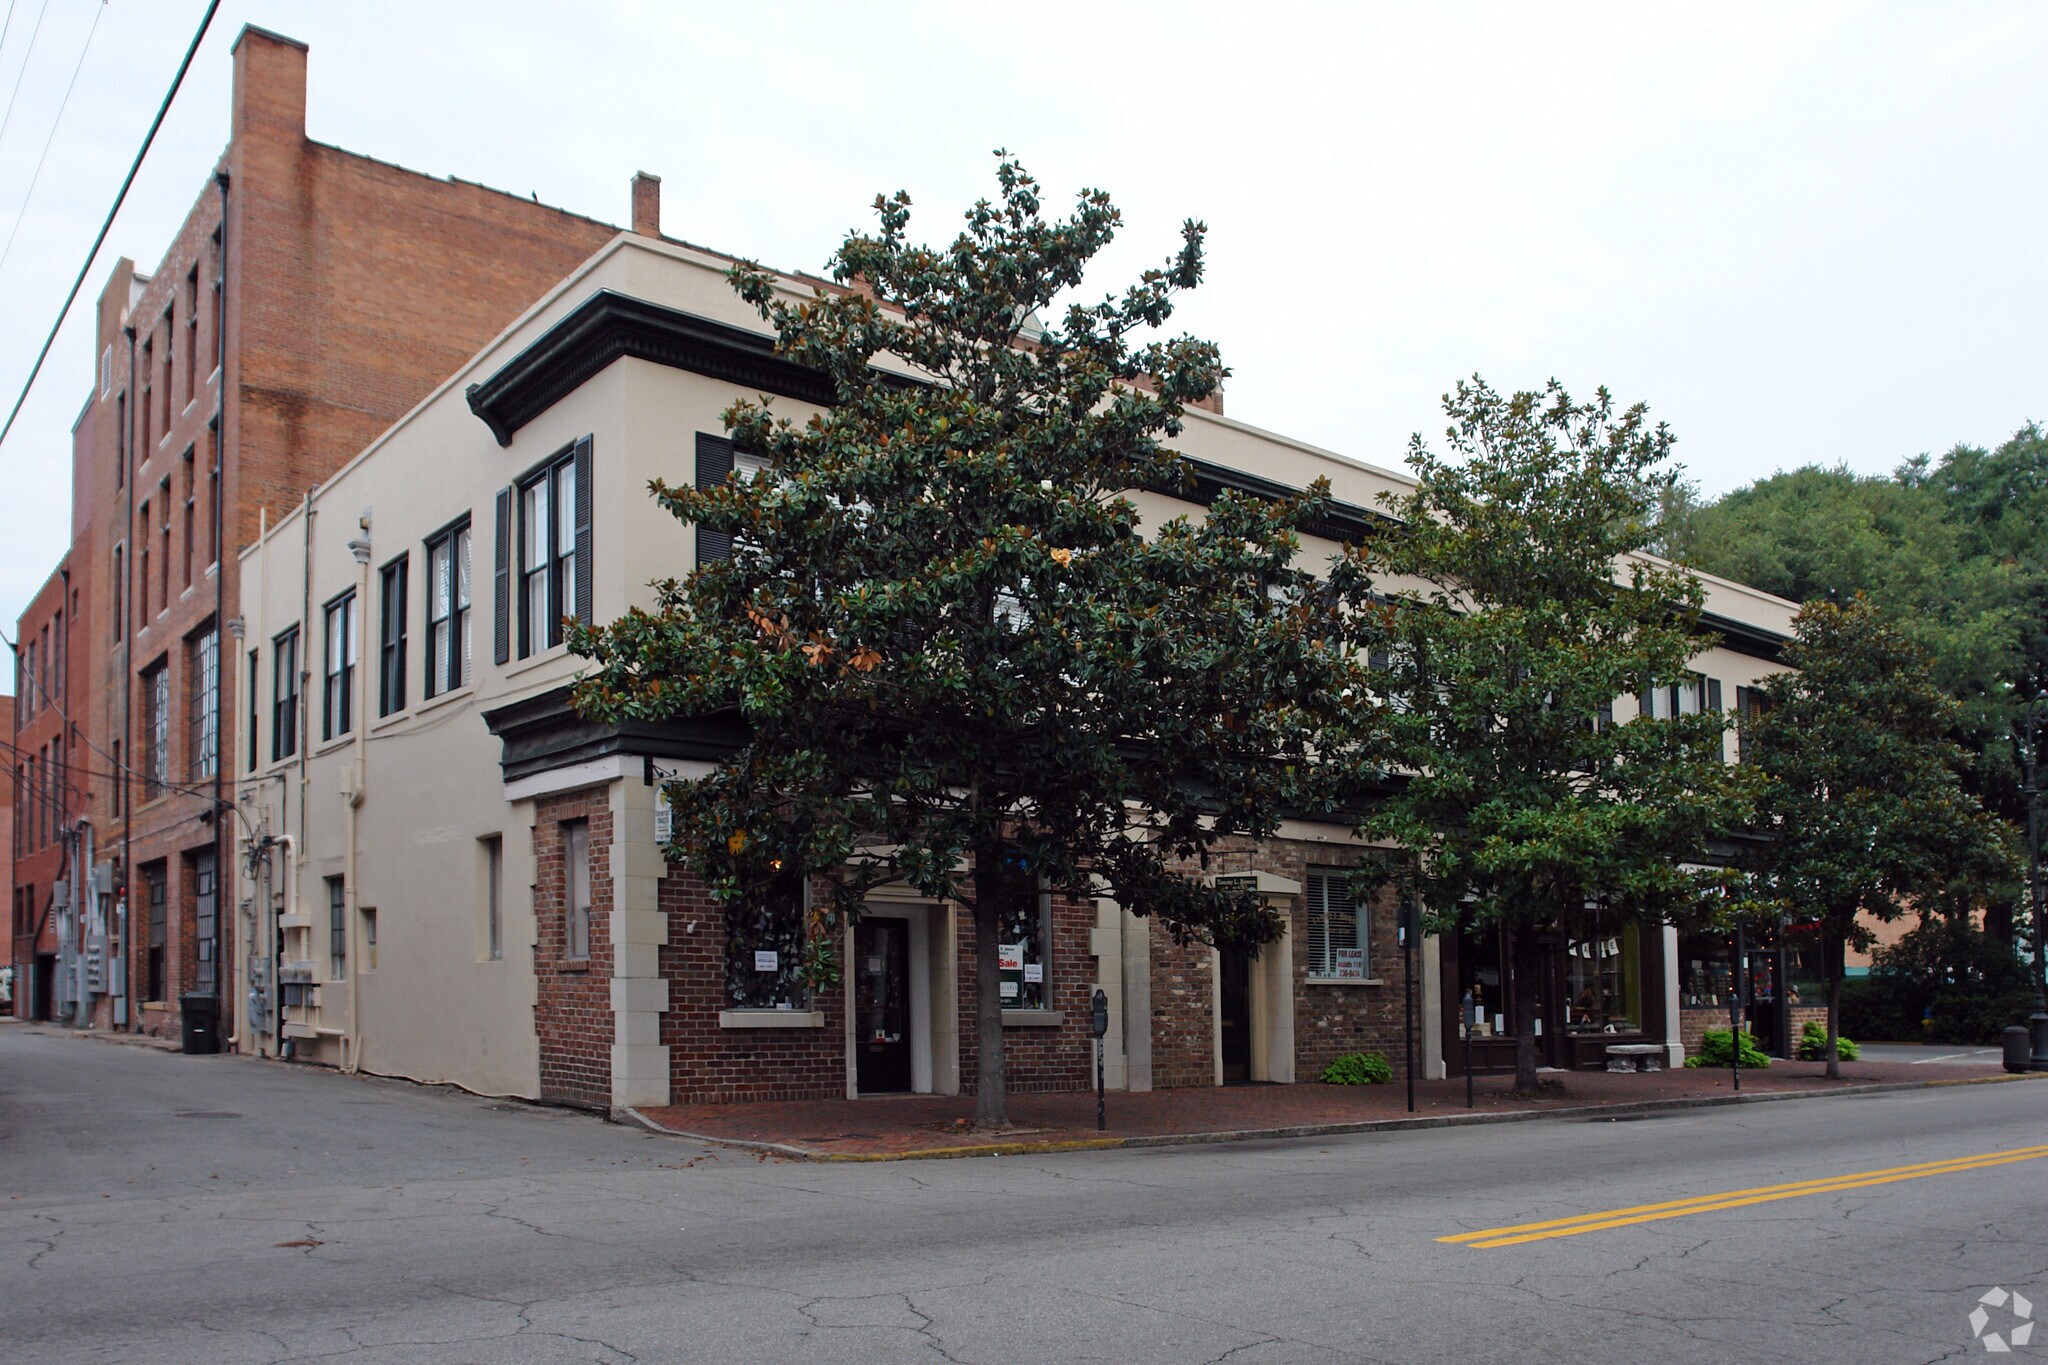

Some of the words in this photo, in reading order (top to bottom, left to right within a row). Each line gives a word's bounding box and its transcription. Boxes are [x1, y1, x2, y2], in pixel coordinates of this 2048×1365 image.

[1338, 950, 1347, 958] FOR
[1349, 950, 1362, 958] LEASE
[998, 958, 1018, 967] Sale
